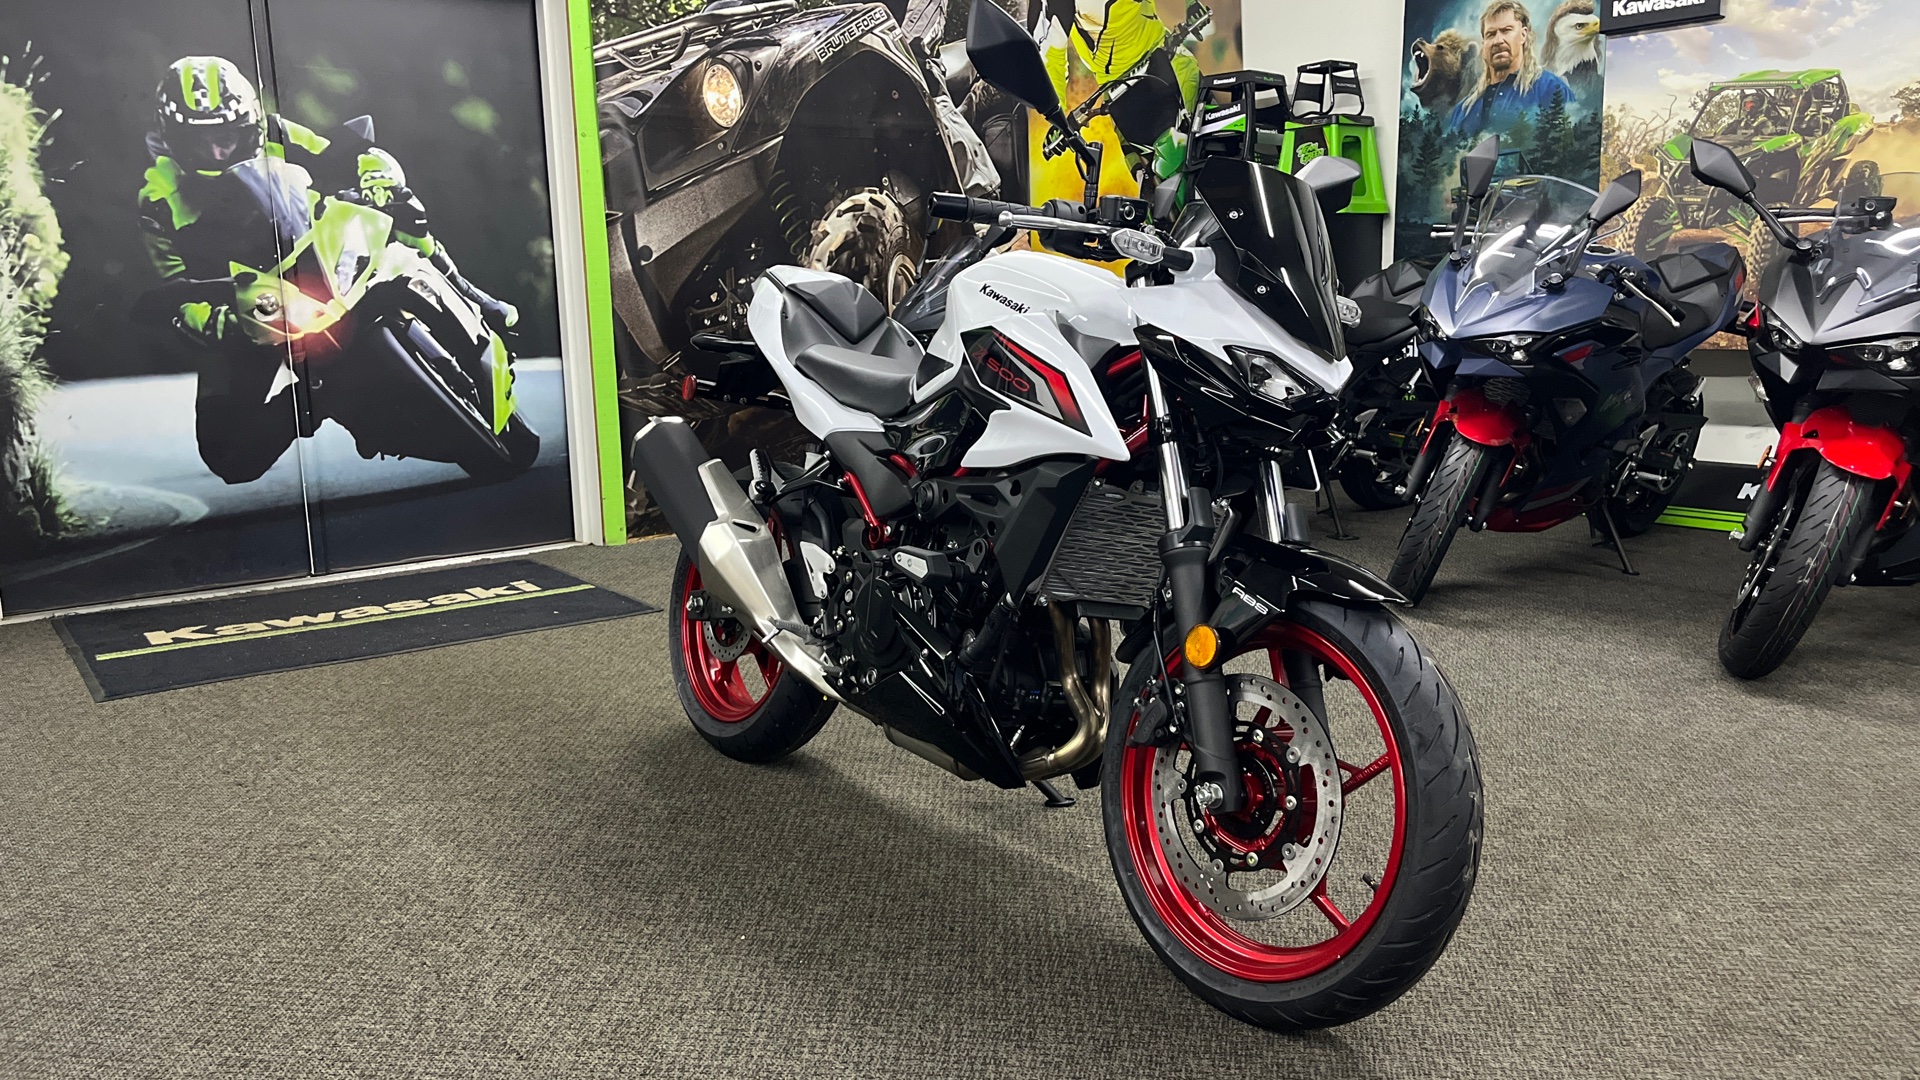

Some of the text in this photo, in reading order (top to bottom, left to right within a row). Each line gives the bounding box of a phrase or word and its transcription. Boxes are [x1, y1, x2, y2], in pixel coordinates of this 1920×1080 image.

[1612, 0, 1705, 18] Kawasa
[815, 7, 888, 62] BRUTE FORCE
[1205, 104, 1241, 121] Kawasaki
[979, 283, 1030, 314] Kawasaki
[143, 579, 542, 645] Kawasaki
[1231, 586, 1269, 615] ABS
